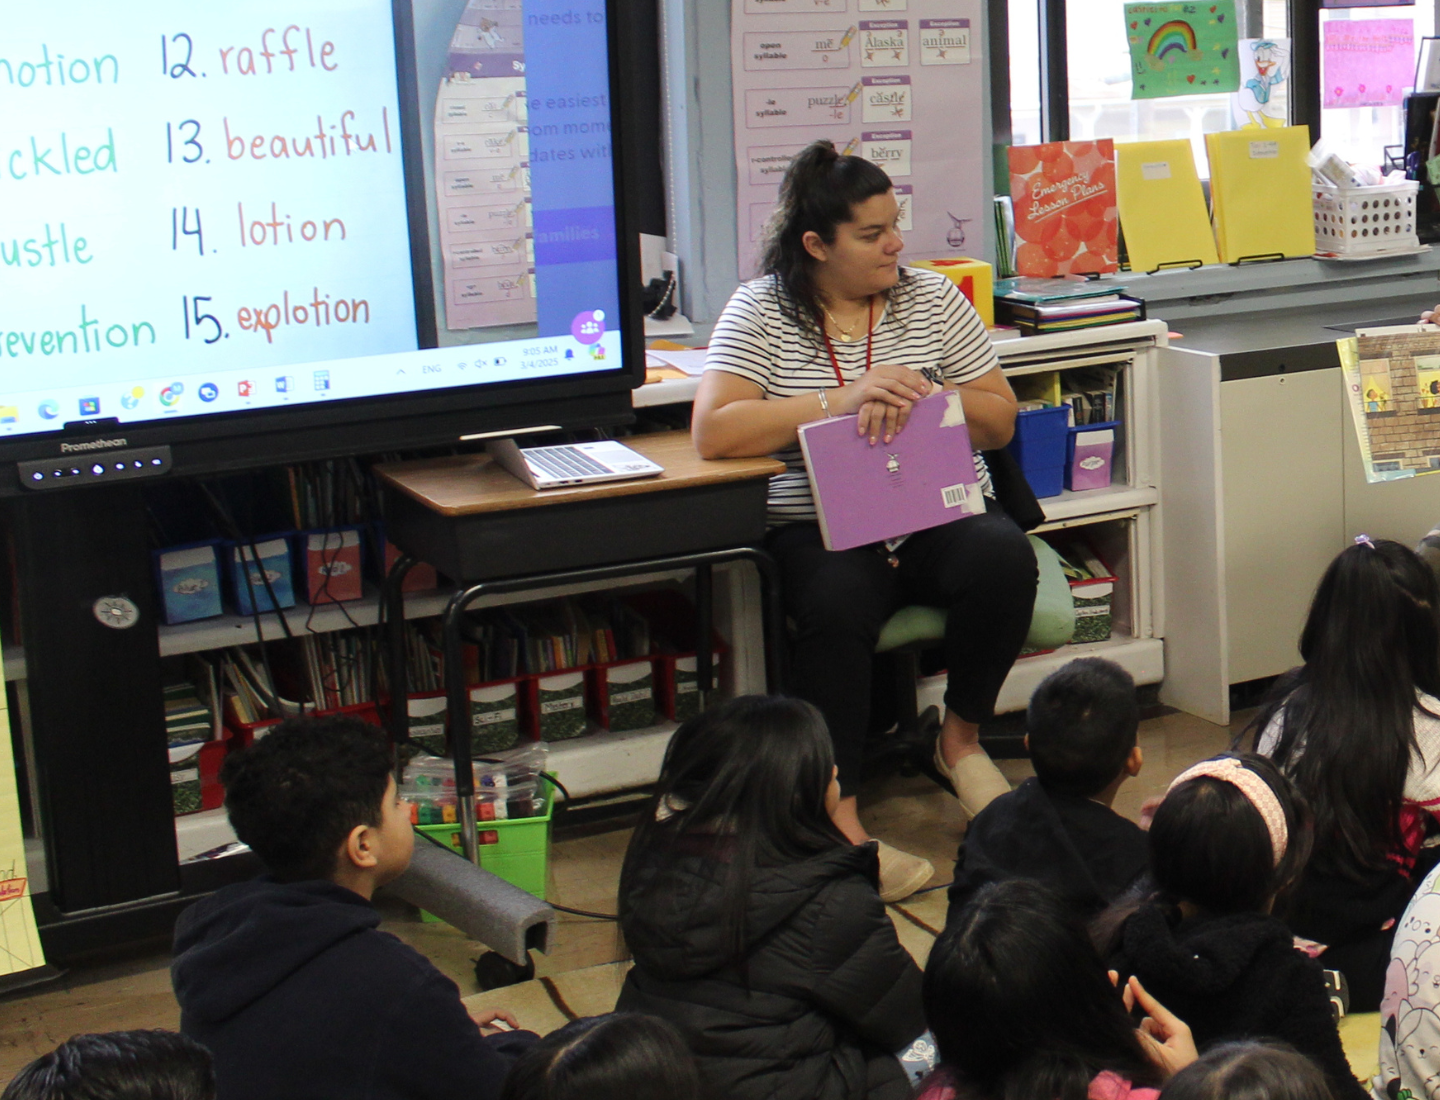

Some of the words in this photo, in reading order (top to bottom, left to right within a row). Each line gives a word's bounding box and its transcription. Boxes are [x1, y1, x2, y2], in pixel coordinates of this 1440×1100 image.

[528, 9, 581, 25] needs
[219, 24, 339, 76] raffle
[754, 52, 787, 60] syllable
[922, 35, 967, 46] animal
[223, 106, 392, 161] beautiful
[1027, 198, 1069, 220] Lesson
[1070, 181, 1105, 201] Plans
[1031, 172, 1090, 200] Emergency
[238, 201, 347, 247] lotion
[237, 286, 370, 344] explotion
[60, 438, 128, 453] Promethean
